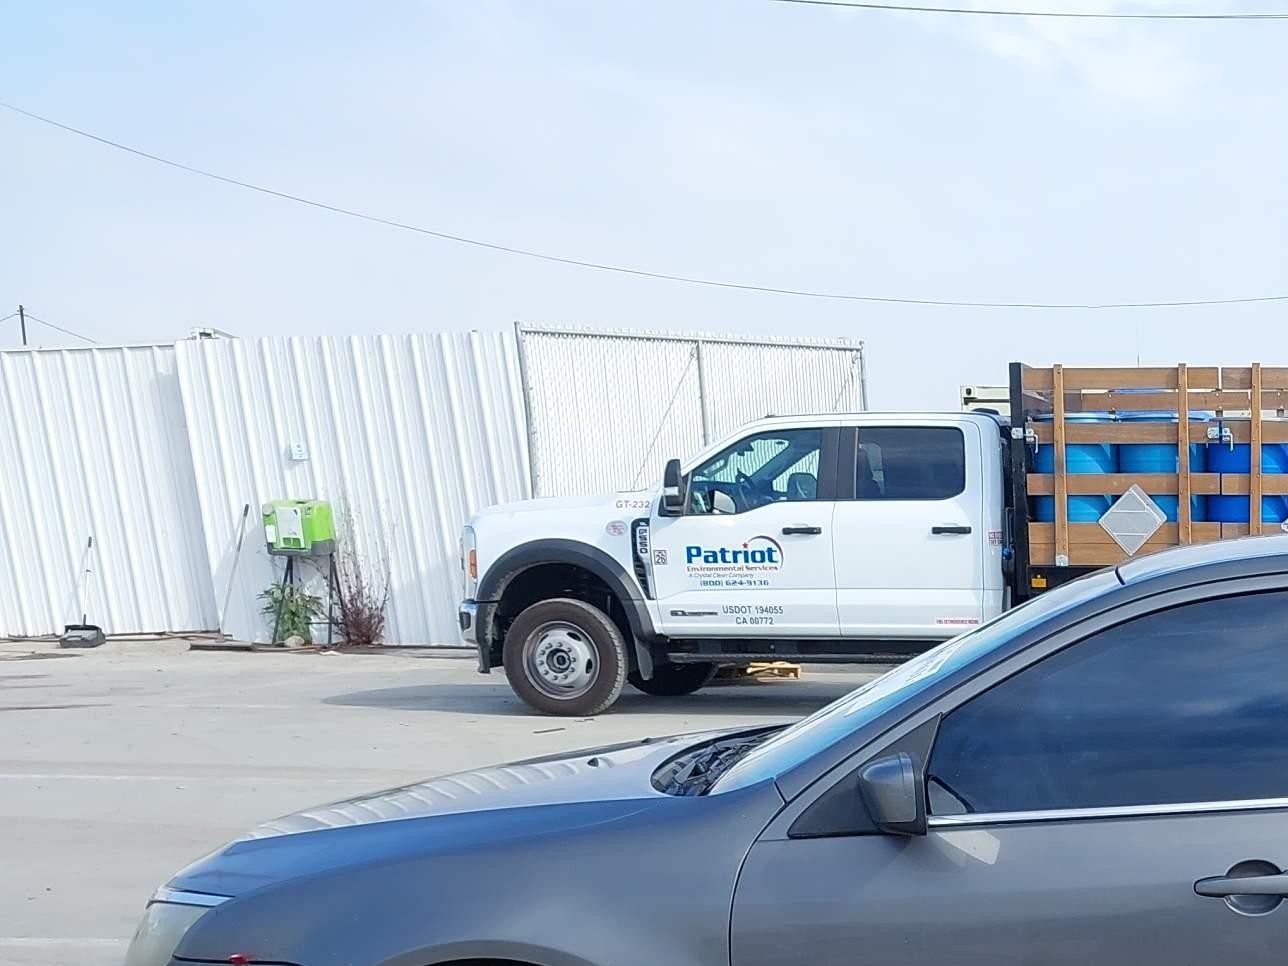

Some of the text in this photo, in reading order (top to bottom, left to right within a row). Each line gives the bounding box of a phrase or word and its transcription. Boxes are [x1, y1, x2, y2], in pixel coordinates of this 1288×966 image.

[615, 500, 650, 508] GT-232
[685, 545, 779, 564] Patriot
[722, 605, 752, 614] USDOT
[755, 605, 784, 614] 194055
[735, 617, 774, 625] CA 00772
